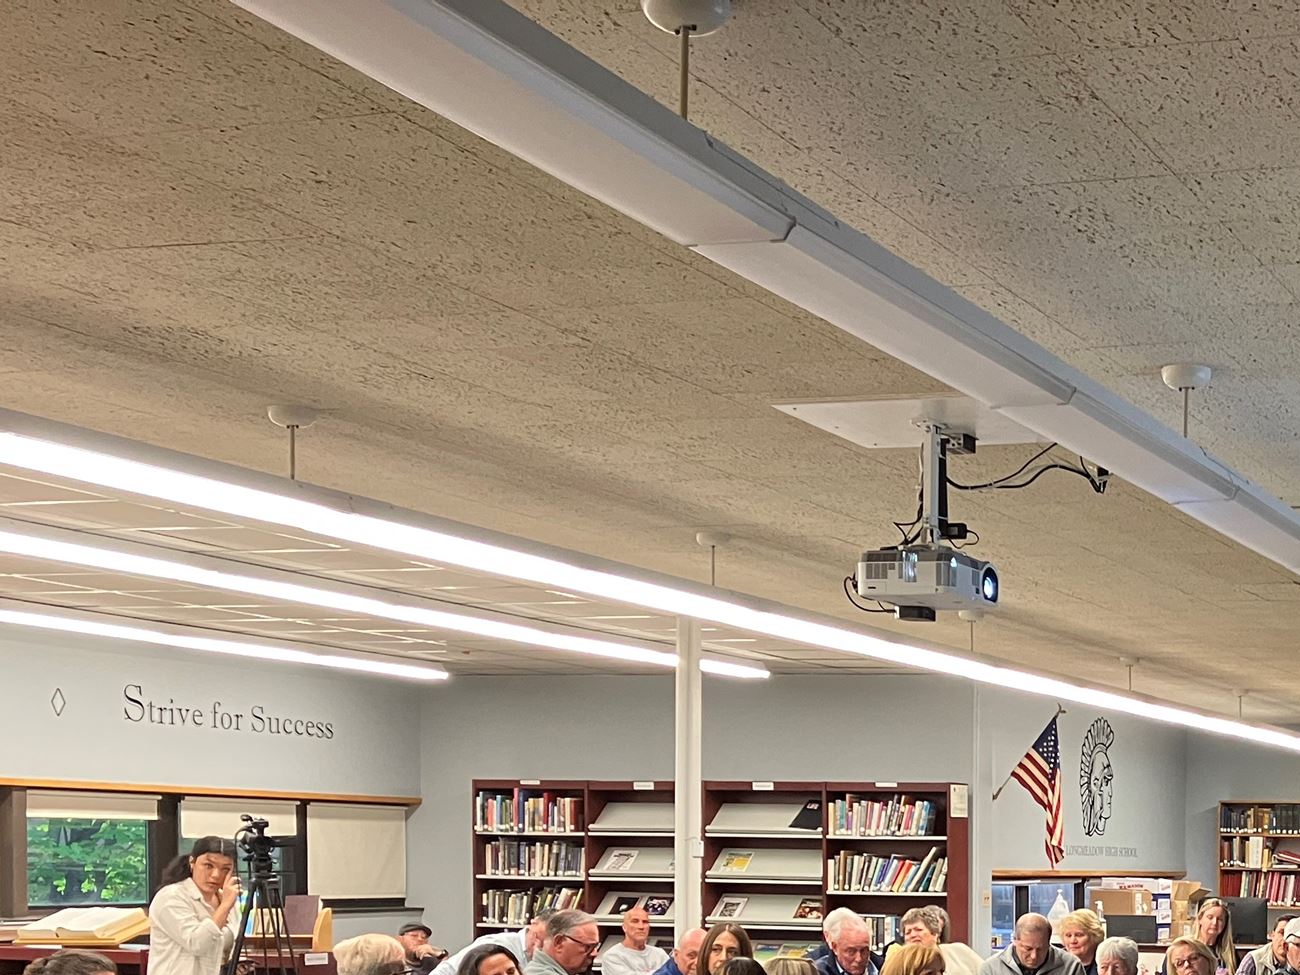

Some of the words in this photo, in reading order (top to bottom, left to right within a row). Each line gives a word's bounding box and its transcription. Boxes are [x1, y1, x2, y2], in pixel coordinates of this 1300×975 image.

[123, 684, 203, 727] Strive
[211, 701, 243, 731] for
[251, 705, 334, 740] Success
[1119, 847, 1139, 858] SCHOOL
